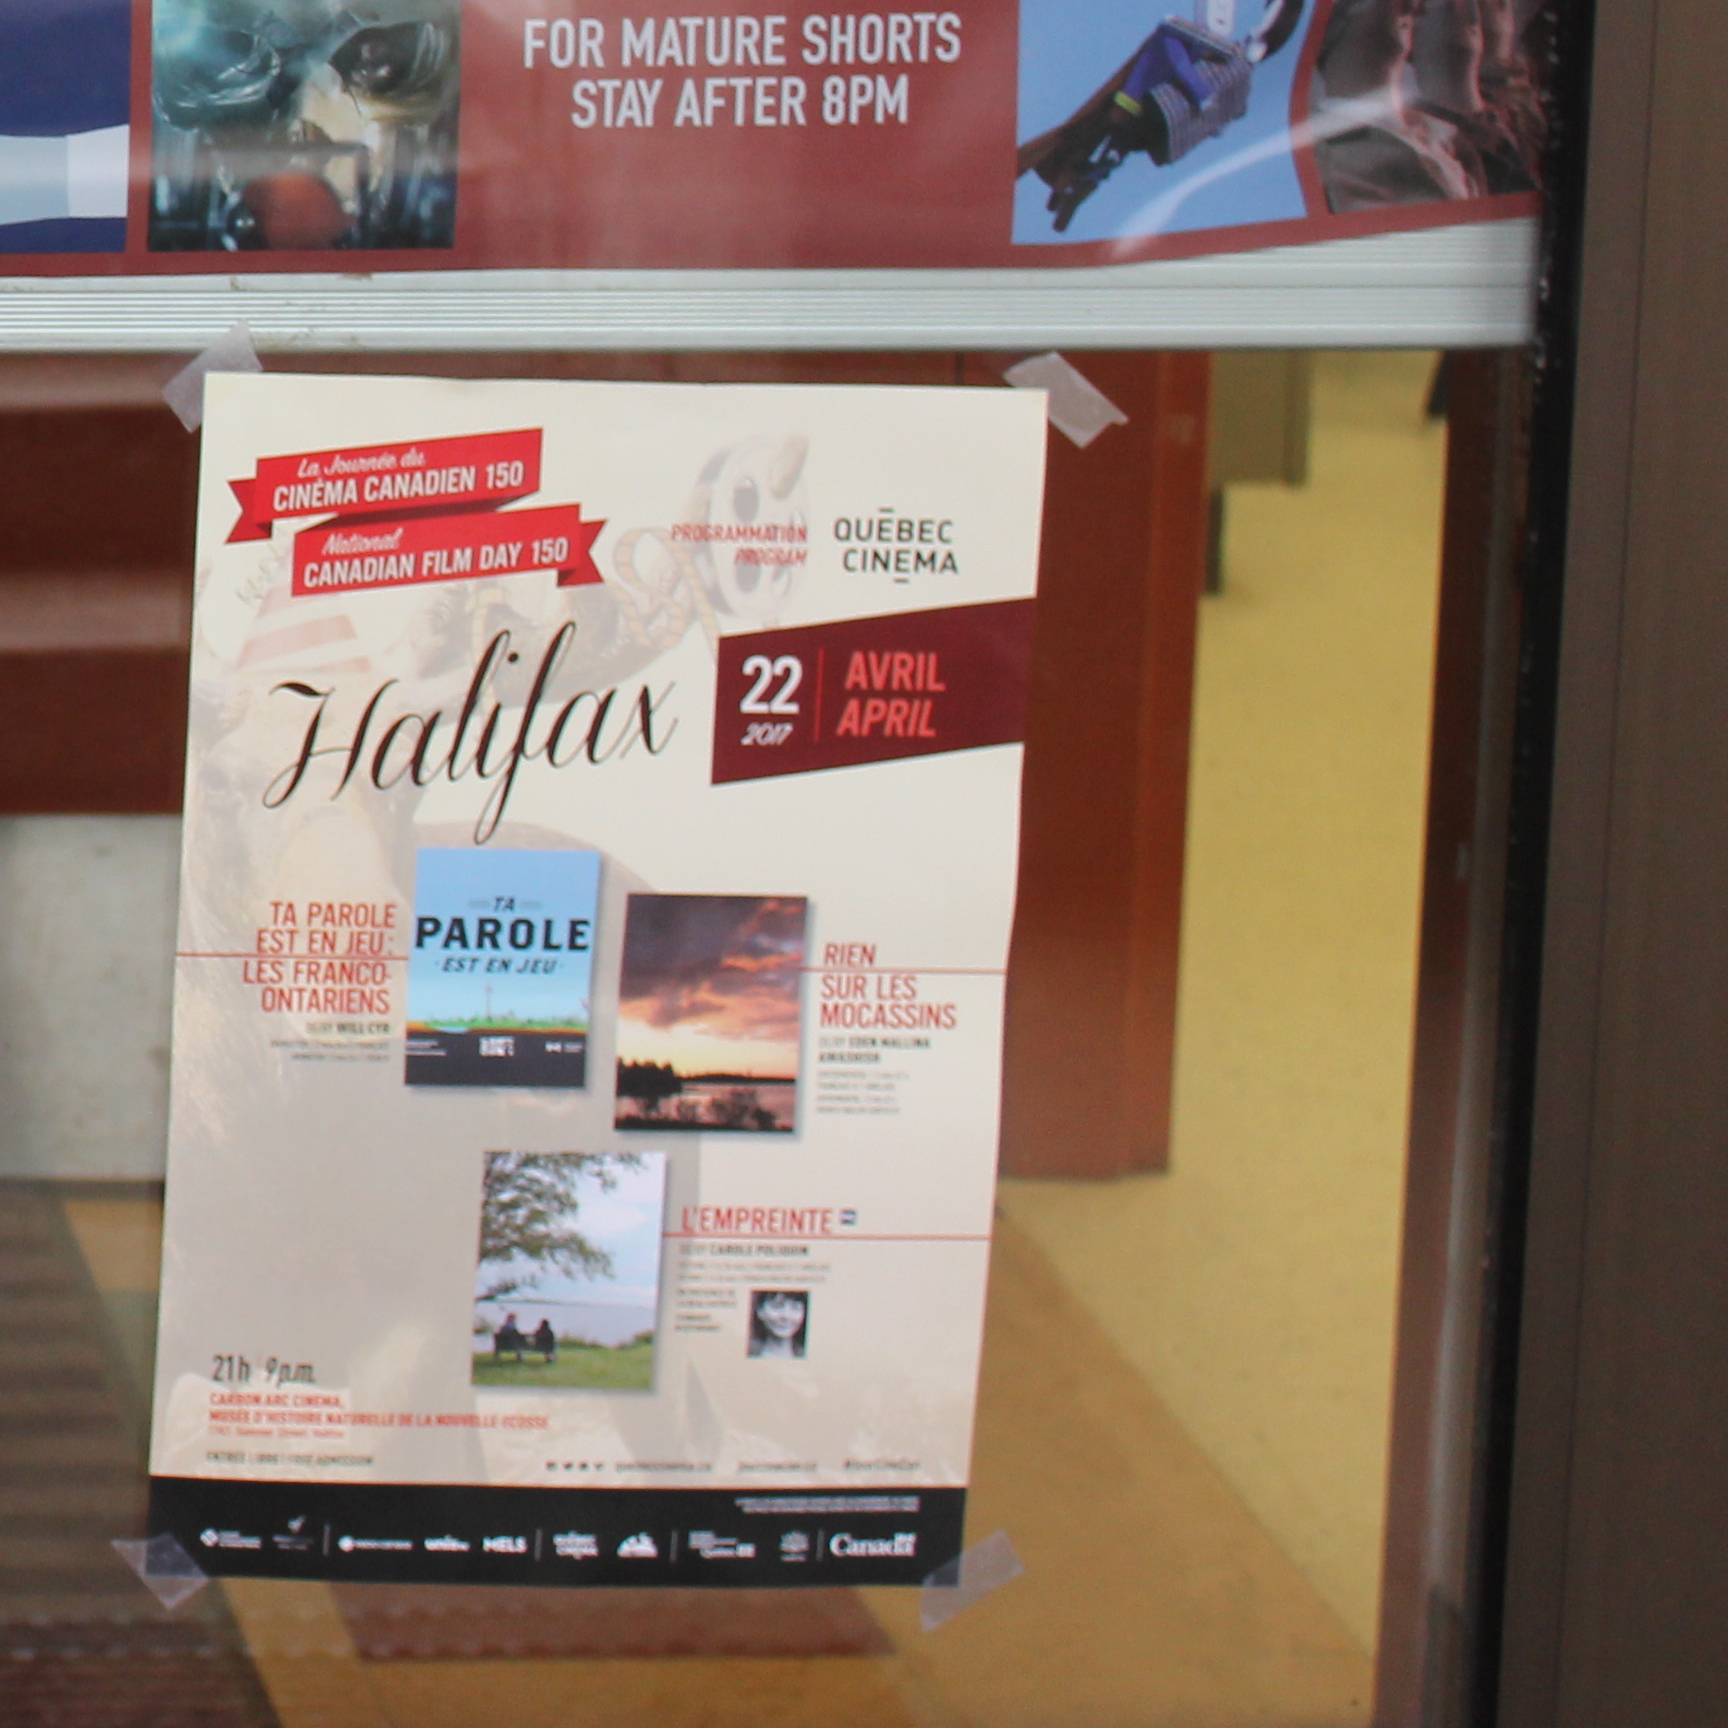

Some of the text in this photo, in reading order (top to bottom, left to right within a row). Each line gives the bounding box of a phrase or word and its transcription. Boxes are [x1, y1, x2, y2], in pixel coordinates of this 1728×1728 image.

[523, 11, 962, 68] FOR MATURE SHORTS
[571, 73, 909, 128] STAY AFTER 8PM
[273, 460, 524, 512] CINÉMA CANADIEN 150
[304, 537, 569, 588] CANADIAN FILM DAY 150
[740, 655, 803, 714] 22
[845, 651, 946, 692] AVRIL
[263, 620, 679, 845] Halifax
[836, 699, 937, 738] APRIL
[270, 901, 396, 928] TA PAROLE
[256, 929, 335, 953] EST EN
[415, 916, 590, 951] PAROLE
[243, 960, 283, 984] LES
[824, 943, 875, 965] RIEN
[262, 986, 390, 1013] ONTARIENS
[821, 975, 917, 999] SUR LES
[820, 1003, 957, 1029] MOCASSINS
